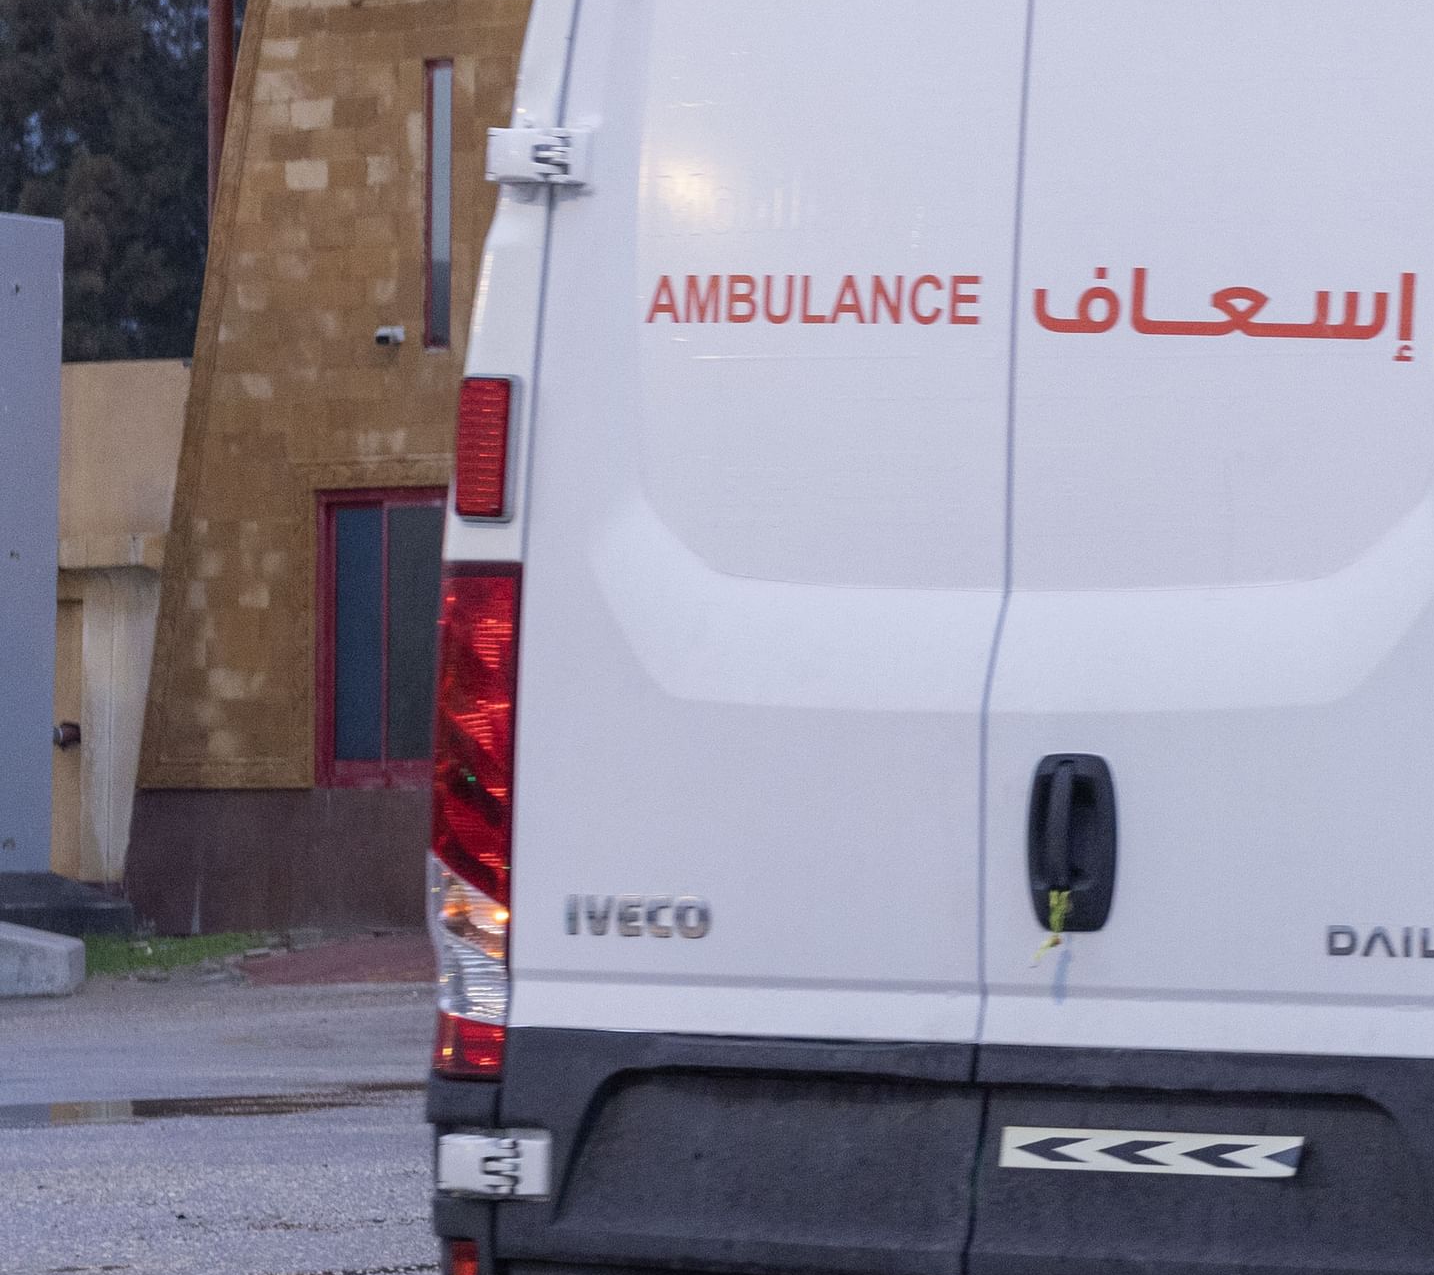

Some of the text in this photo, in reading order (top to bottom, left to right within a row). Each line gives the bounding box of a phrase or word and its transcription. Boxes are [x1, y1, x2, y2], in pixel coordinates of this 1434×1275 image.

[647, 275, 982, 325] AMBULANCE
[1033, 267, 1416, 362] إسعاف
[565, 893, 711, 939] IVECO
